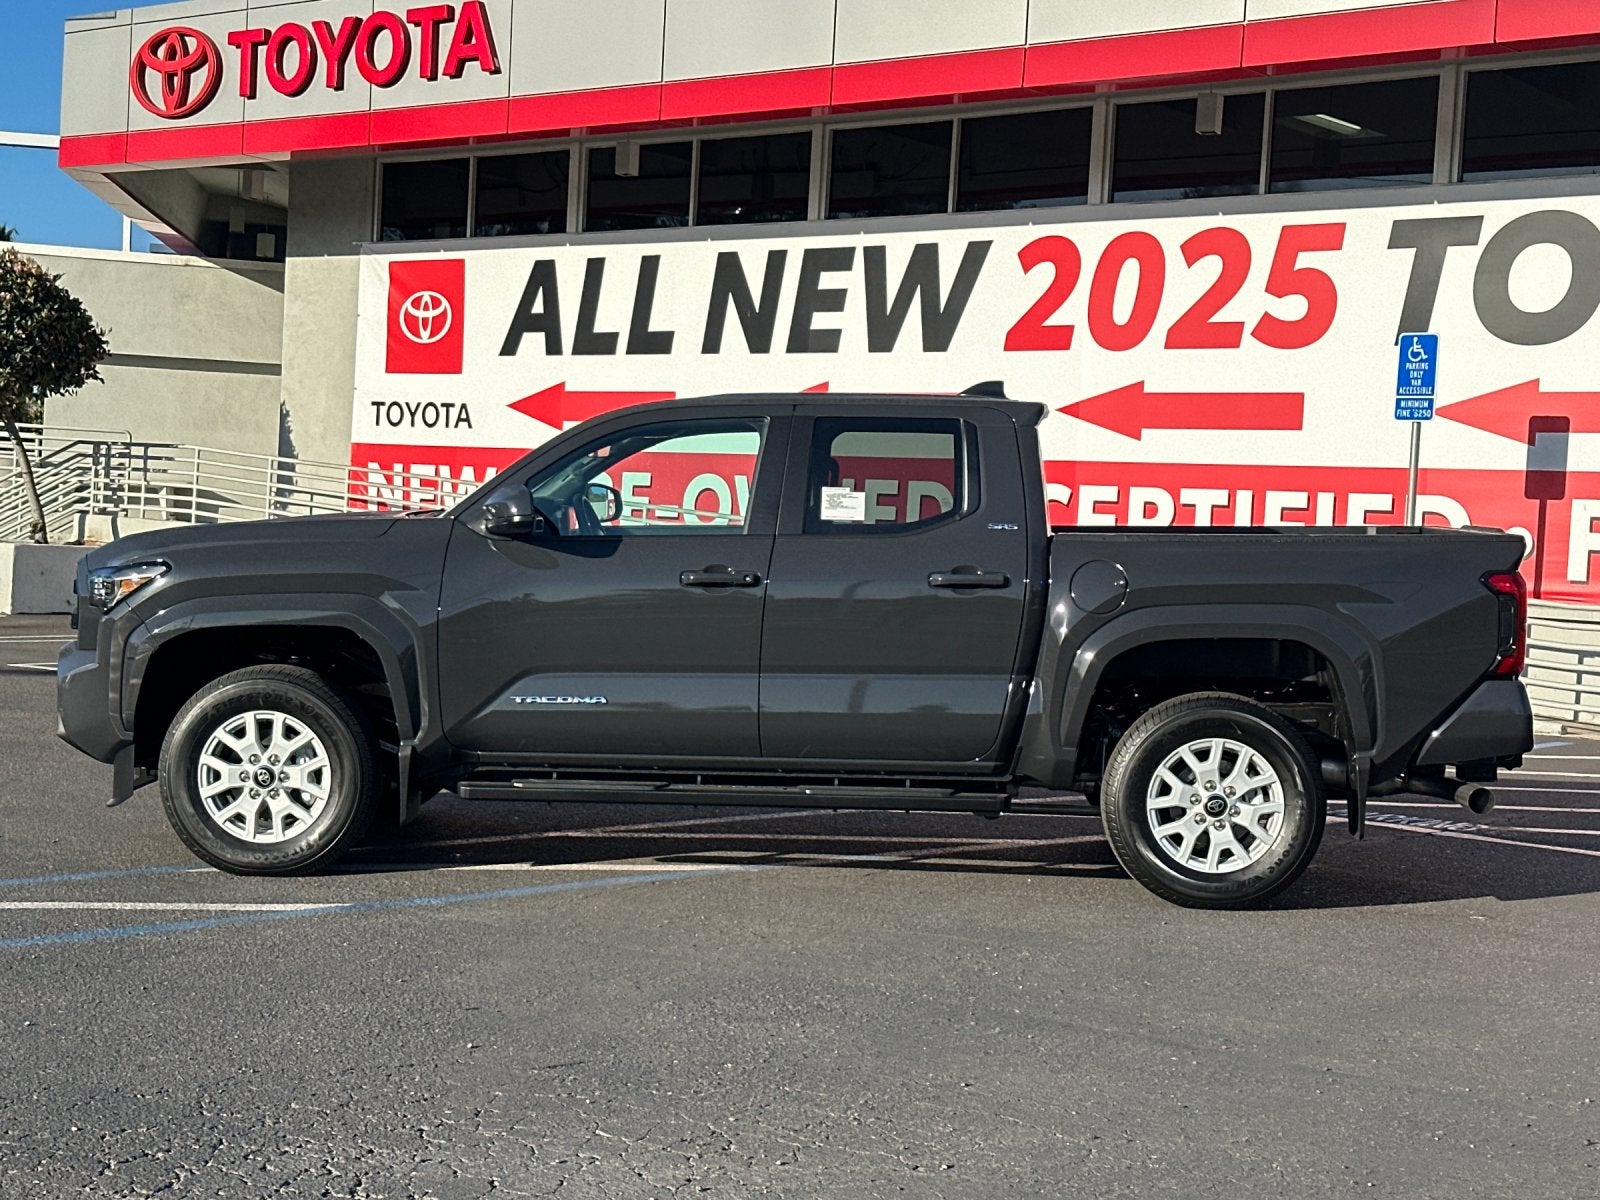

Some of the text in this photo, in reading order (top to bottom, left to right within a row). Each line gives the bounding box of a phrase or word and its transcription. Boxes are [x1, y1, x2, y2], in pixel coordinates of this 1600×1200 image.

[228, 0, 501, 99] TOYOTA
[498, 255, 675, 356] ALL
[701, 240, 993, 354] NEW
[1003, 221, 1347, 351] 2025
[1406, 362, 1429, 370] PARKING
[1409, 370, 1424, 378] ONLY
[1399, 386, 1432, 395] ACCESSIBLE
[1400, 400, 1429, 408] MINIMUM
[371, 400, 473, 429] TOYOTA
[1396, 409, 1432, 418] FINE $250
[510, 696, 607, 704] TACOMA
